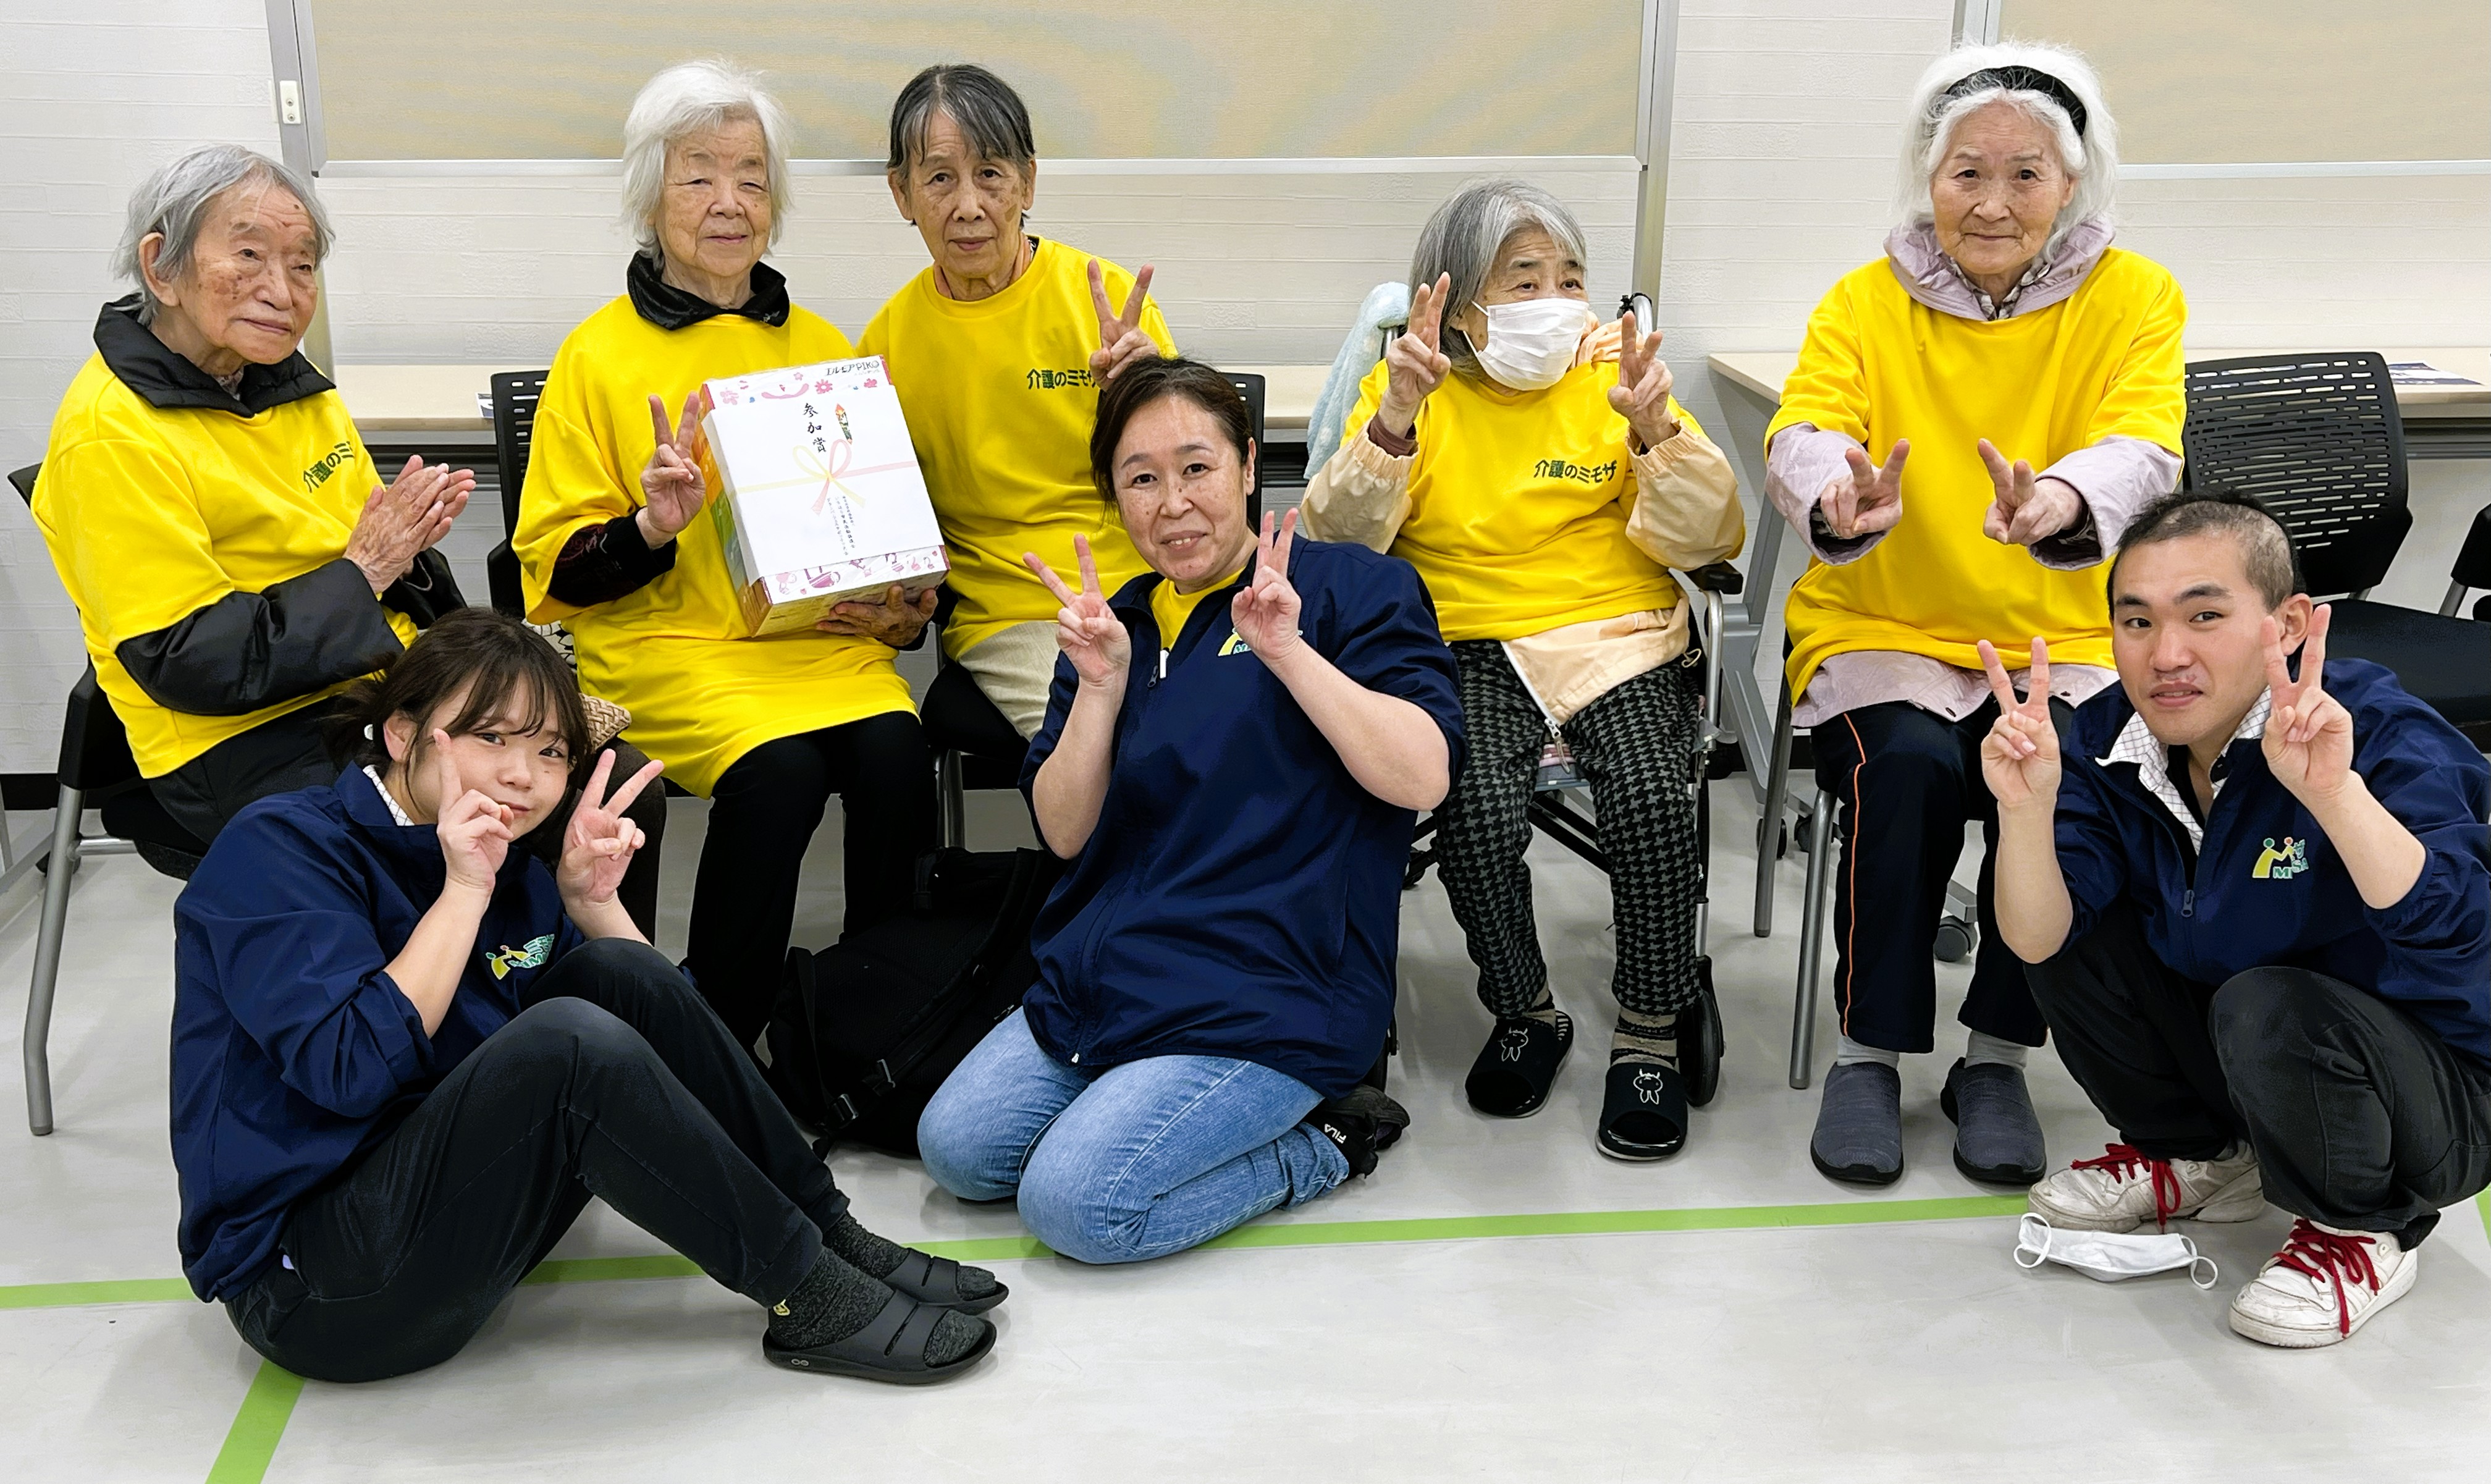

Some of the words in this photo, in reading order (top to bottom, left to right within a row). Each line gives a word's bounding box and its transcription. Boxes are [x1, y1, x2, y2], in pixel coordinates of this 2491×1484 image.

[803, 402, 827, 453] 参加賞
[303, 441, 355, 493] 介護のミ
[1533, 459, 1617, 484] 介護のミモザ
[1324, 1123, 1347, 1144] FILA
